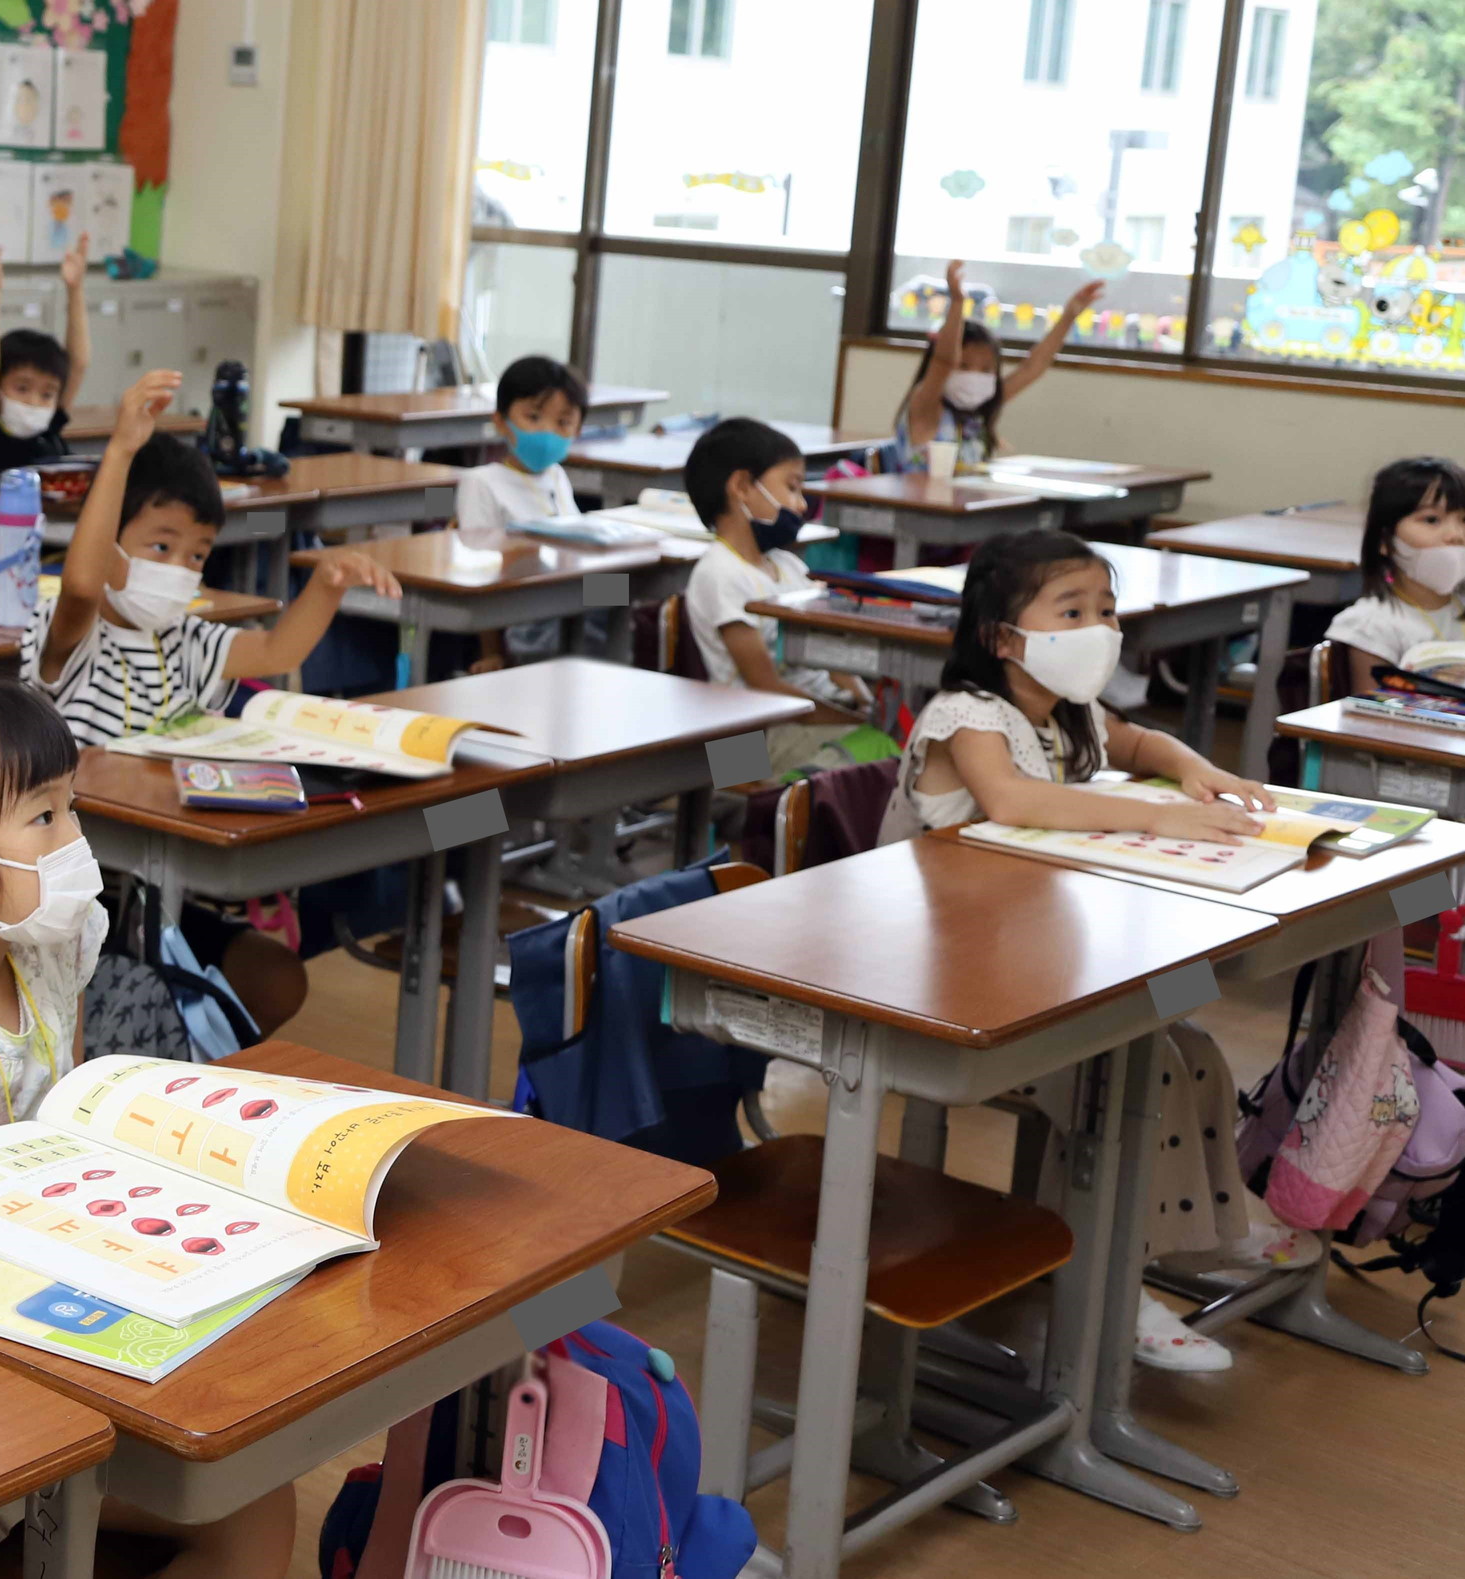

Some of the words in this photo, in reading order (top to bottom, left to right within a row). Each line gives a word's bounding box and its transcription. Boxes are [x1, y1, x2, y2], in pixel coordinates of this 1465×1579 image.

[323, 1121, 362, 1155] 바꾸어
[310, 1159, 333, 1195] 보자.
[52, 1302, 80, 1317] 상
